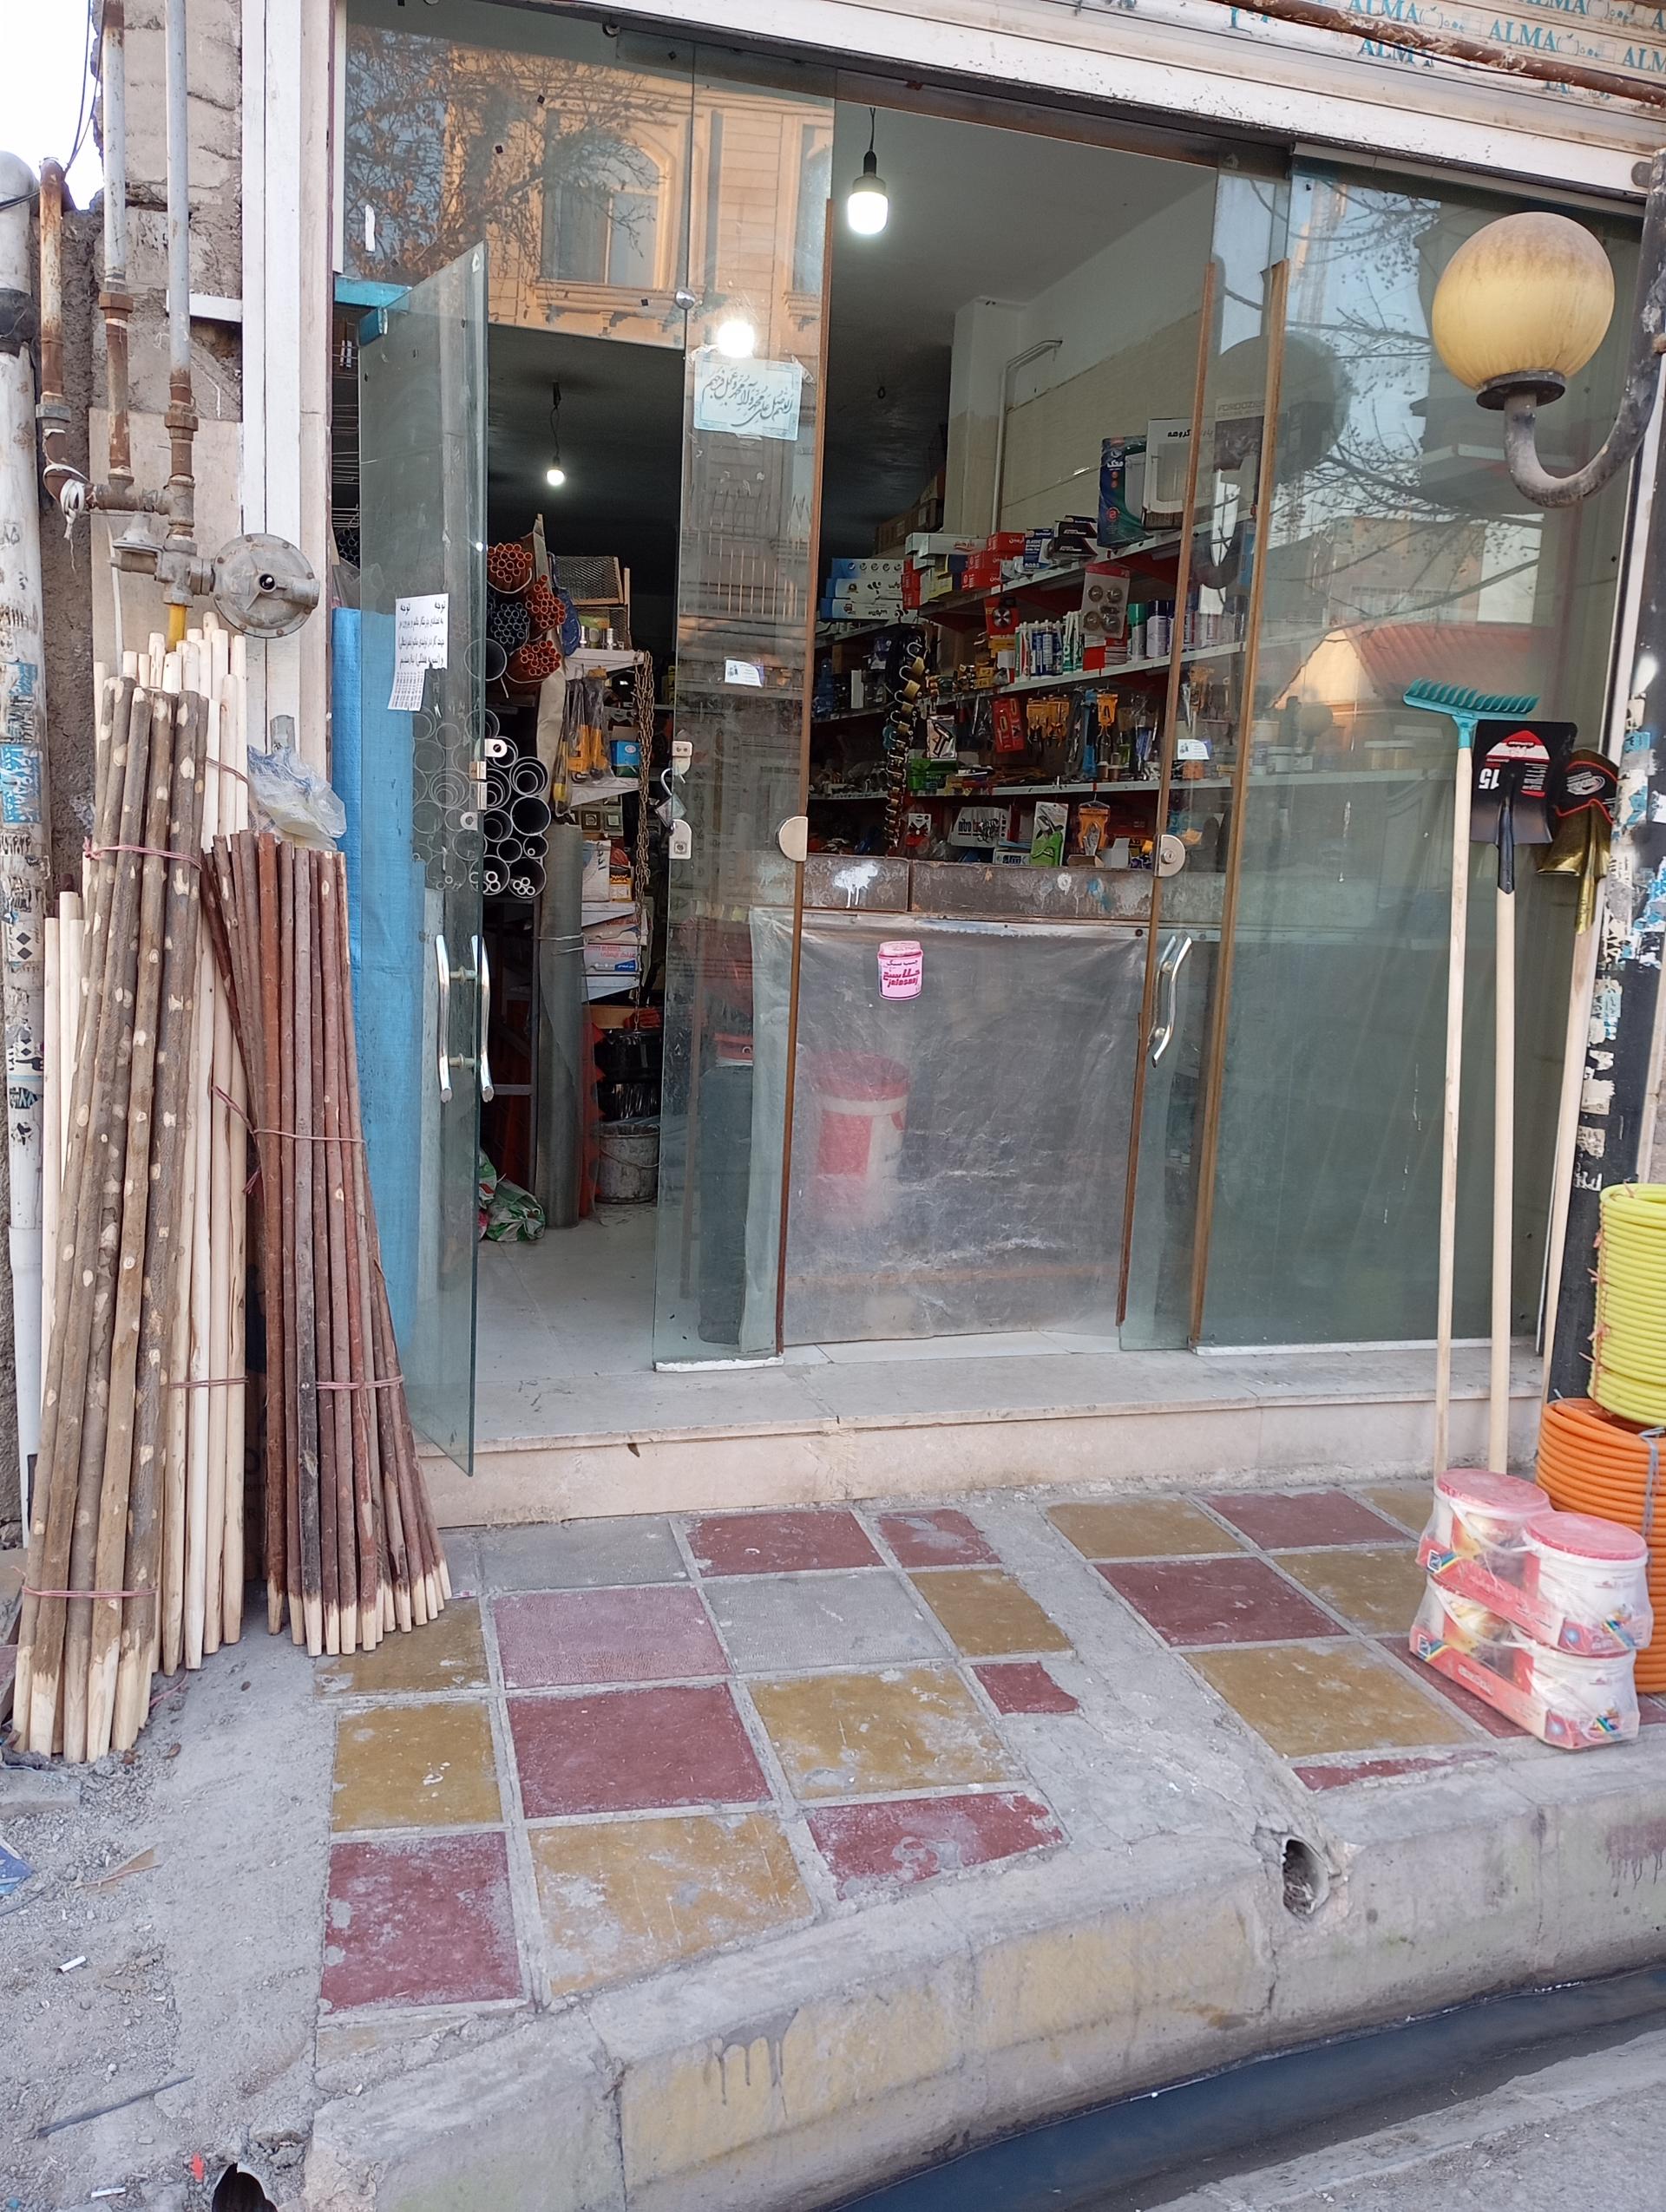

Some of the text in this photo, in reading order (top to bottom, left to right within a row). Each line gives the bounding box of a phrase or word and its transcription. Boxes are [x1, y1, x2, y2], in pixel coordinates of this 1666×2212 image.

[1348, 0, 1666, 74] ALMA ALMA ALM
[1478, 768, 1500, 790] 15
